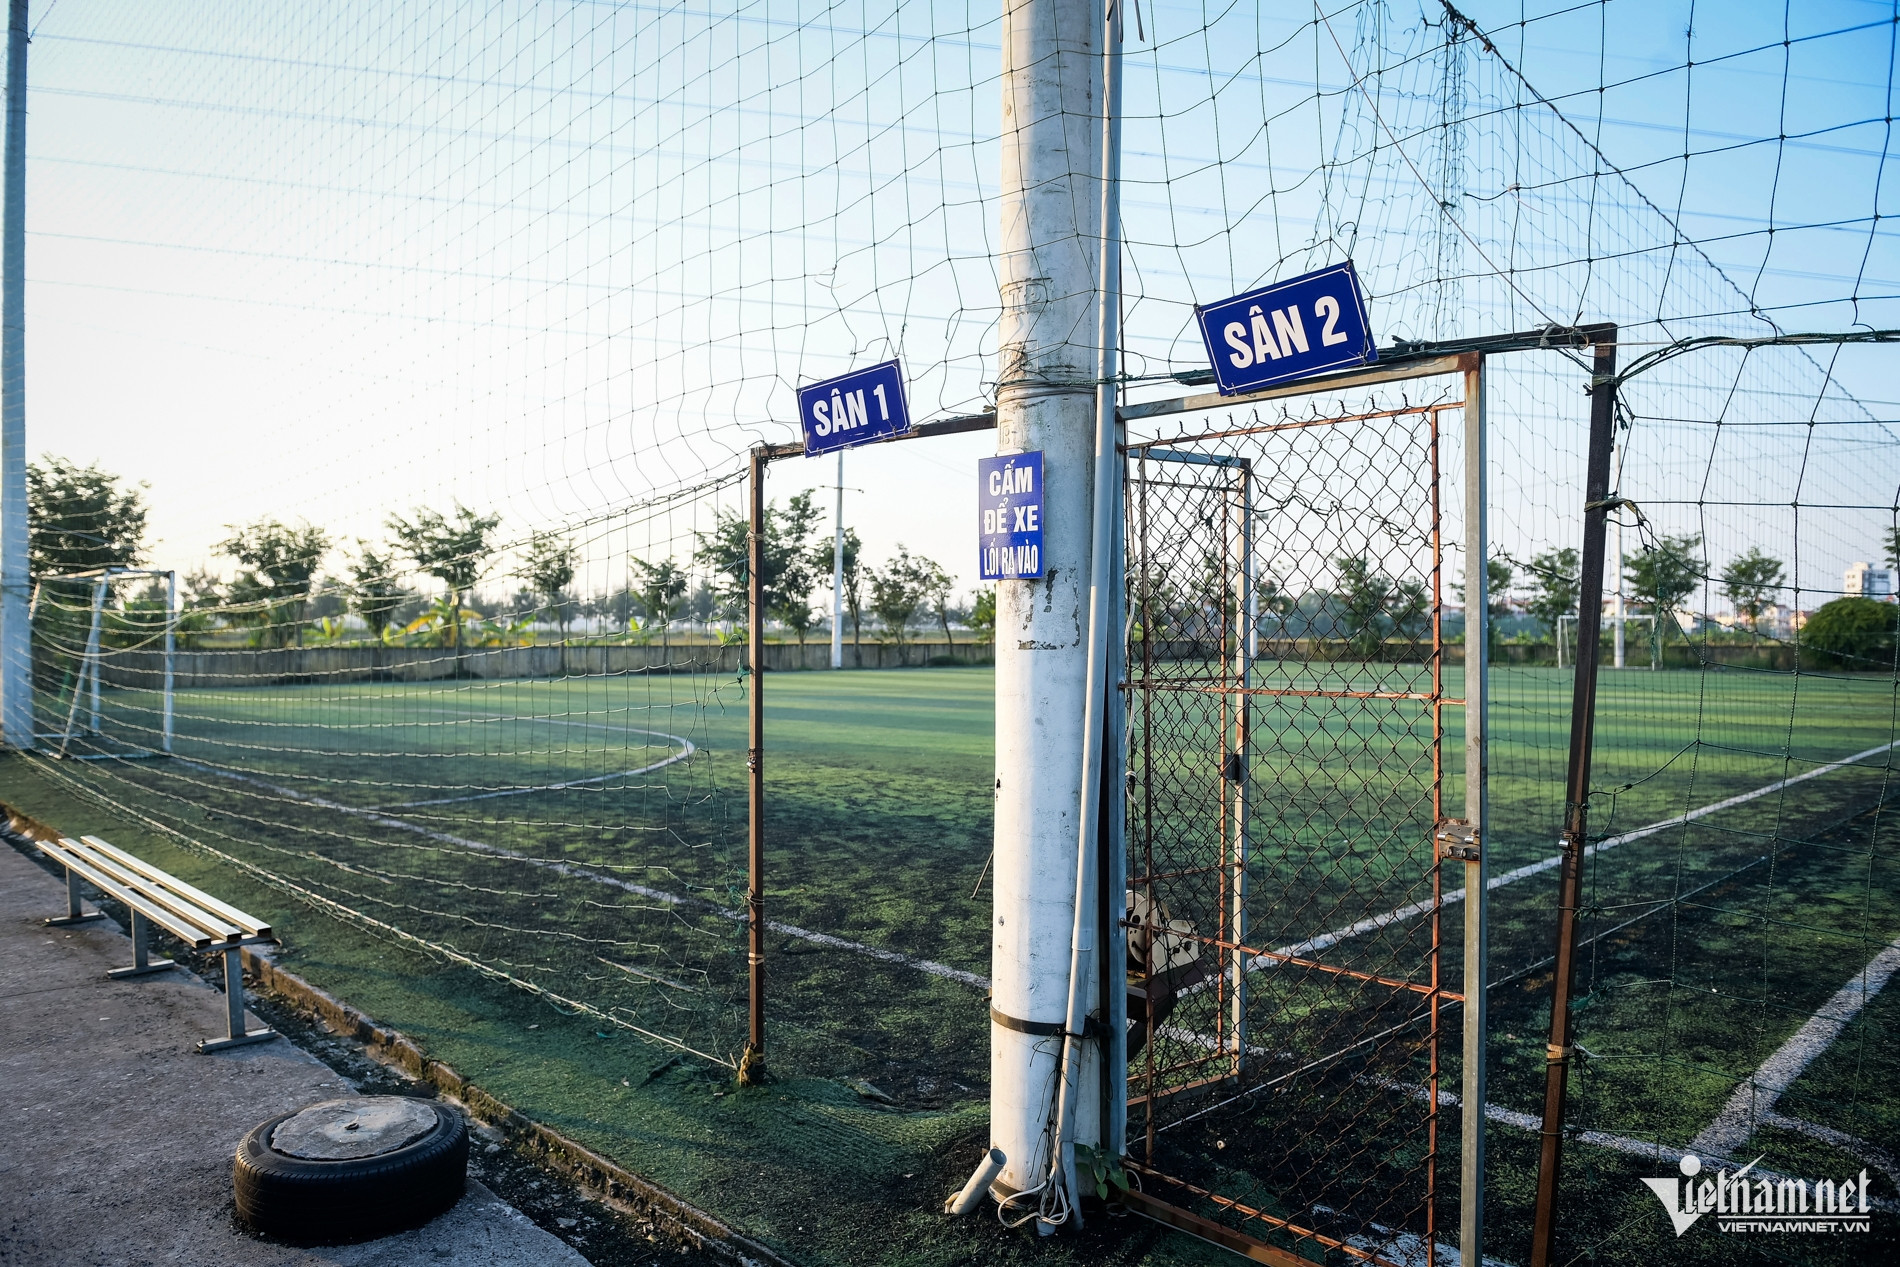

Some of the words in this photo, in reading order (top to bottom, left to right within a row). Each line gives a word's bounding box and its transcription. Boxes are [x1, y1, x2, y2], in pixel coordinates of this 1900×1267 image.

[1224, 305, 1309, 369] SÂN
[1314, 296, 1348, 347] 2
[813, 387, 868, 437] SÂN
[873, 383, 889, 421] 1
[989, 459, 1033, 497] CẤM
[983, 497, 1008, 535] ĐỂ
[1013, 505, 1039, 533] XE
[983, 537, 999, 576] LỐI
[1001, 546, 1015, 575] RA
[1017, 539, 1039, 575] VÀO
